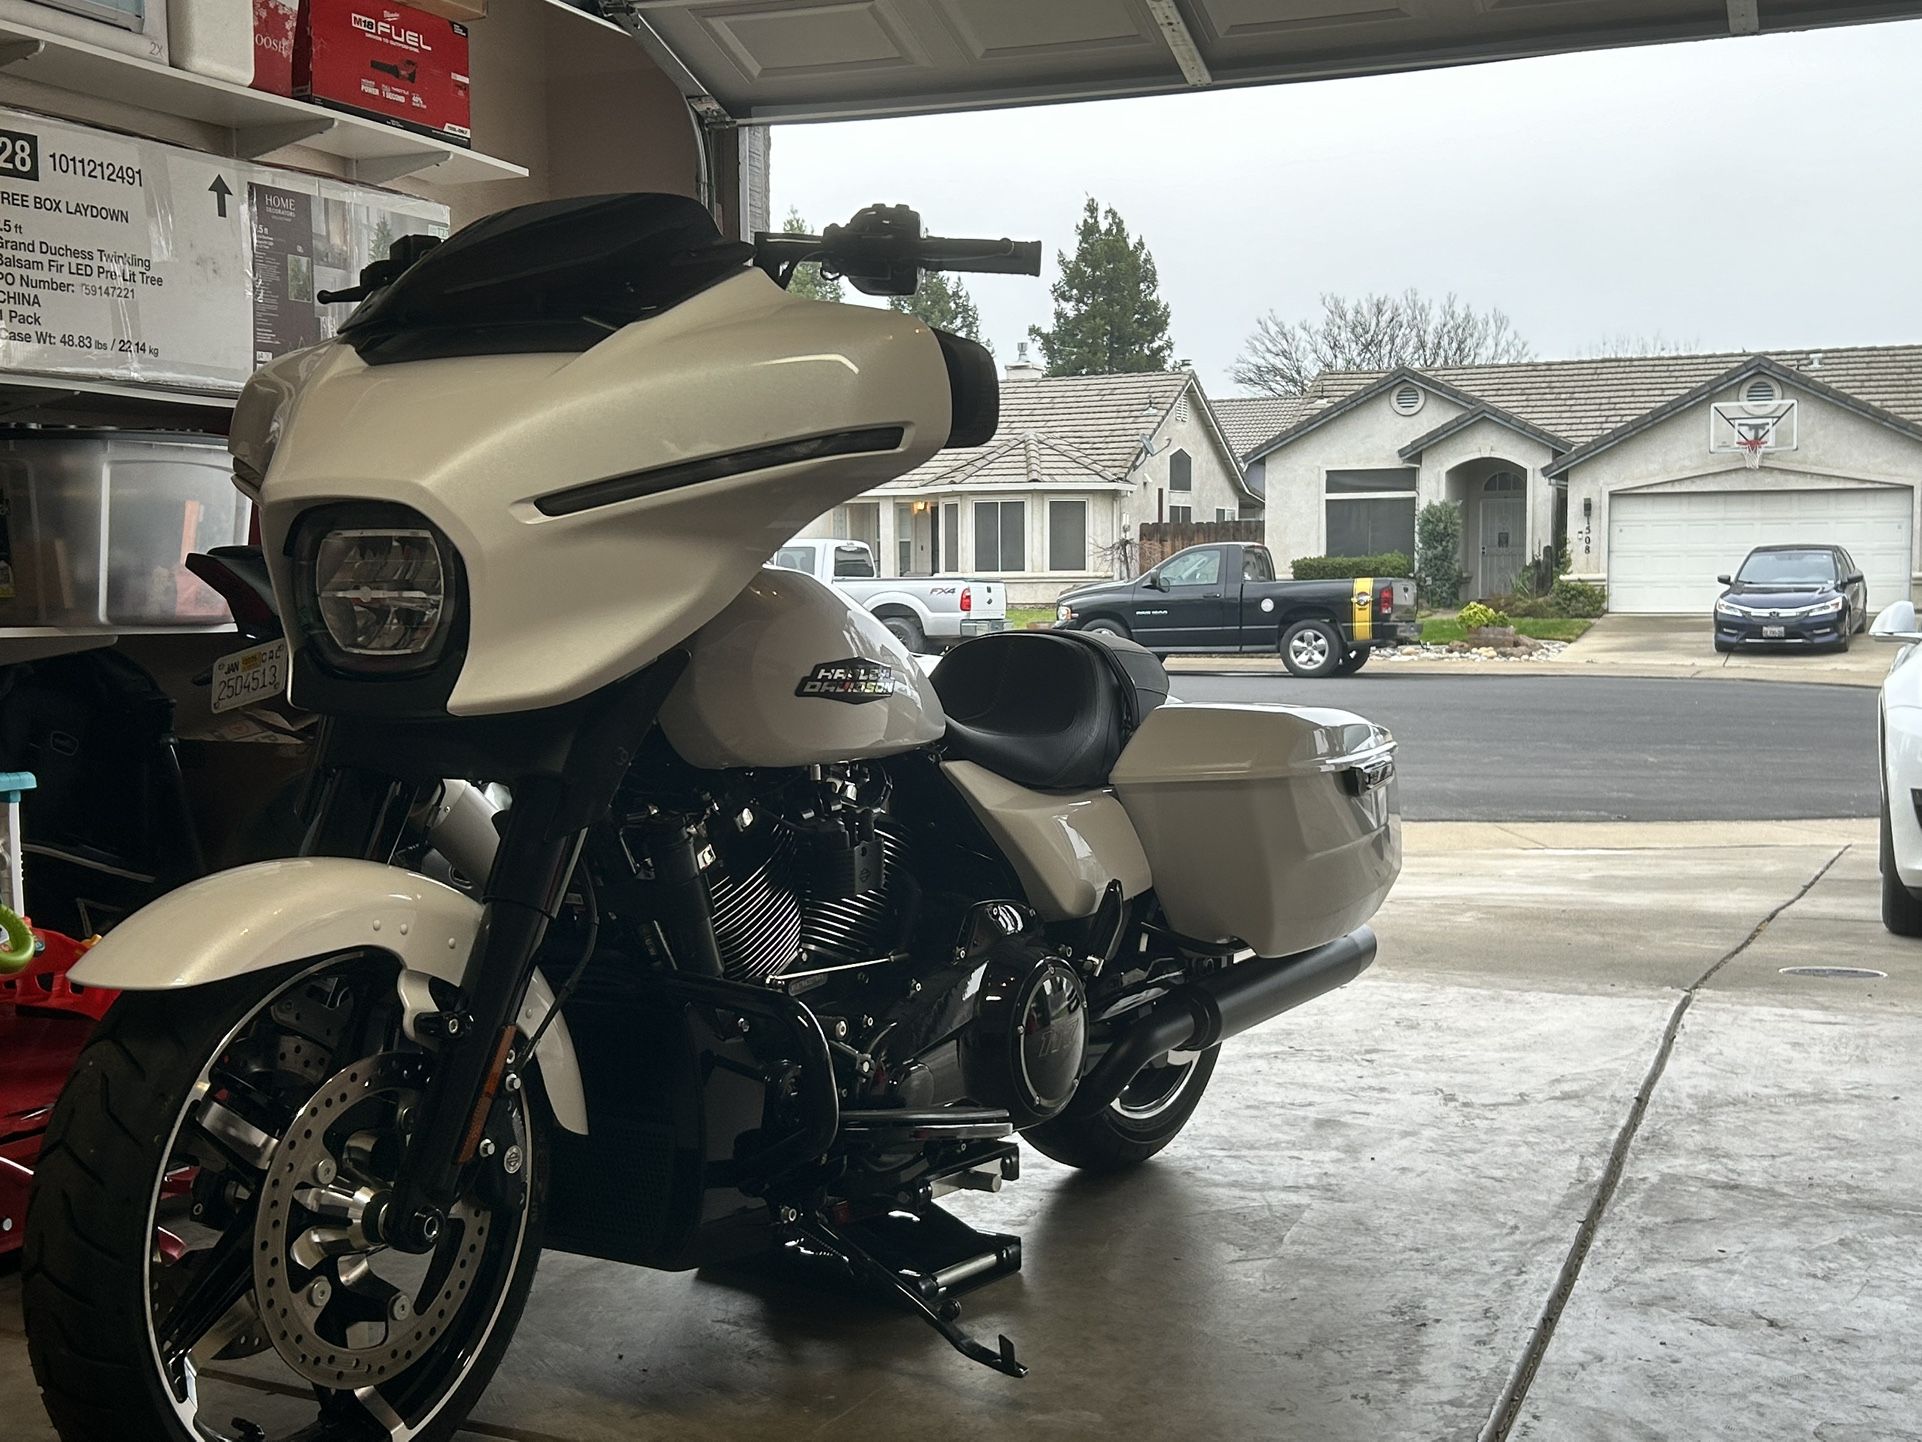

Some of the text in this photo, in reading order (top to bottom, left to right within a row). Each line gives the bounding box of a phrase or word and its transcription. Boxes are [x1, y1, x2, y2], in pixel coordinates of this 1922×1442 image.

[353, 16, 374, 31] M18
[378, 21, 432, 51] FUEL
[150, 41, 164, 58] 2X
[0, 136, 32, 173] 28
[49, 152, 143, 187] 1011212491
[33, 196, 62, 213] BOX
[66, 201, 129, 223] LAYDOWN
[265, 194, 295, 211] HOME
[14, 223, 23, 235] ft
[39, 241, 94, 261] Duchess
[97, 248, 151, 272] Twinkling
[20, 273, 75, 293] Number:
[48, 259, 64, 274] Fir
[68, 262, 94, 278] LED
[139, 271, 164, 287] Tree
[0, 290, 42, 307] CHINA
[8, 309, 42, 326] Pack
[0, 327, 32, 343] Case
[35, 331, 56, 345] Wt:
[60, 334, 92, 349] 48.83
[95, 340, 108, 351] lbs
[110, 339, 116, 351] /
[149, 345, 159, 357] kg
[929, 587, 956, 595] FX4
[224, 660, 240, 675] JAN
